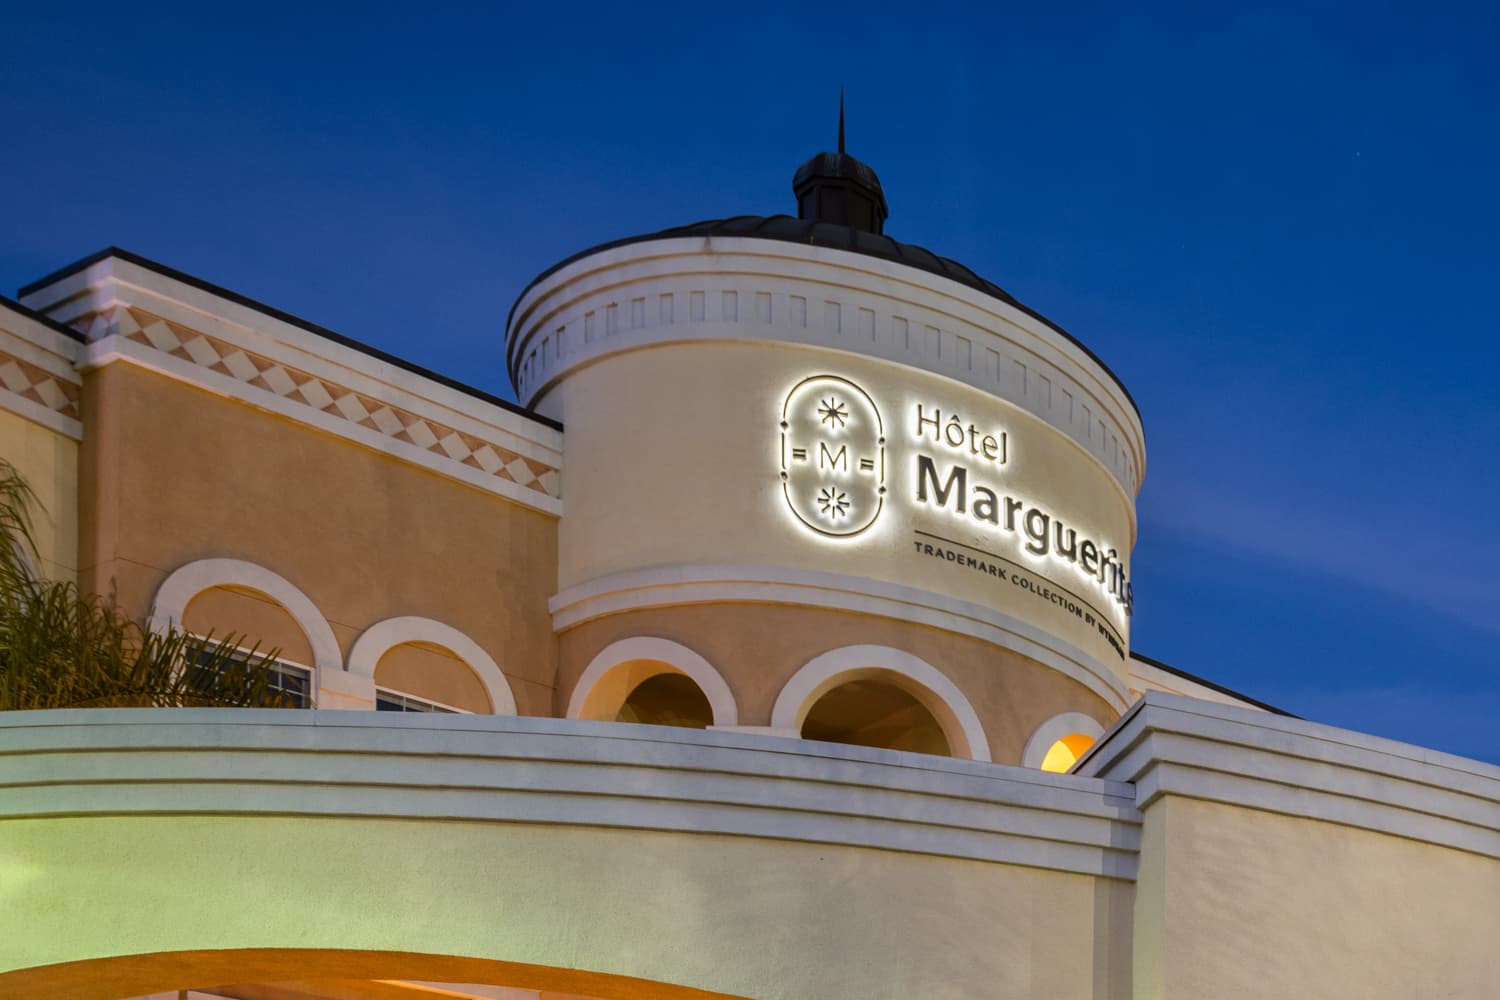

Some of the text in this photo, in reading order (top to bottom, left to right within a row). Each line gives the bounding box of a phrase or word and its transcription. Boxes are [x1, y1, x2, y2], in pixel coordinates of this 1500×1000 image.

[820, 442, 847, 472] M
[917, 404, 1008, 464] Hôtel
[914, 541, 1097, 627] TRADEMARK COLLECTION BY
